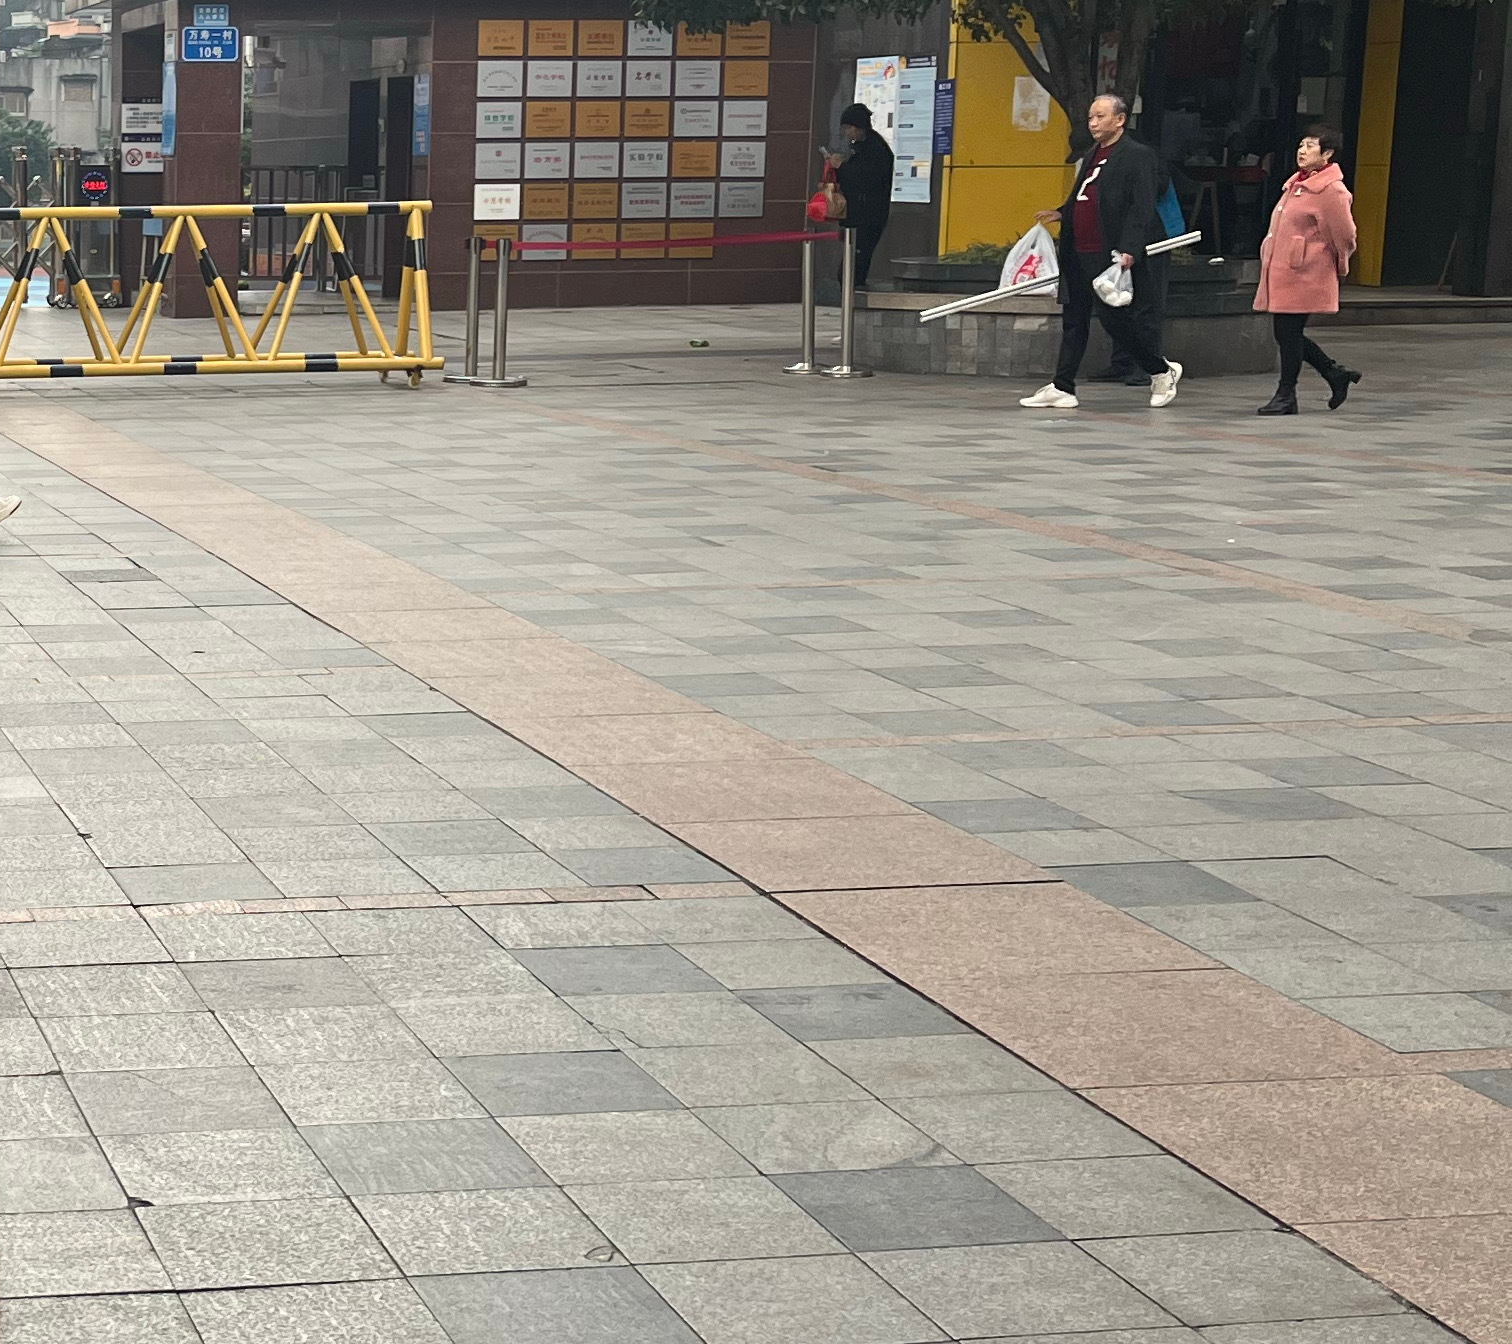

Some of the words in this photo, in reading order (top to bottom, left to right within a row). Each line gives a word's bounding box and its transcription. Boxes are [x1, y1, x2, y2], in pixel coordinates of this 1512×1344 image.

[188, 30, 233, 41] 万寿一村
[198, 46, 223, 59] 10号
